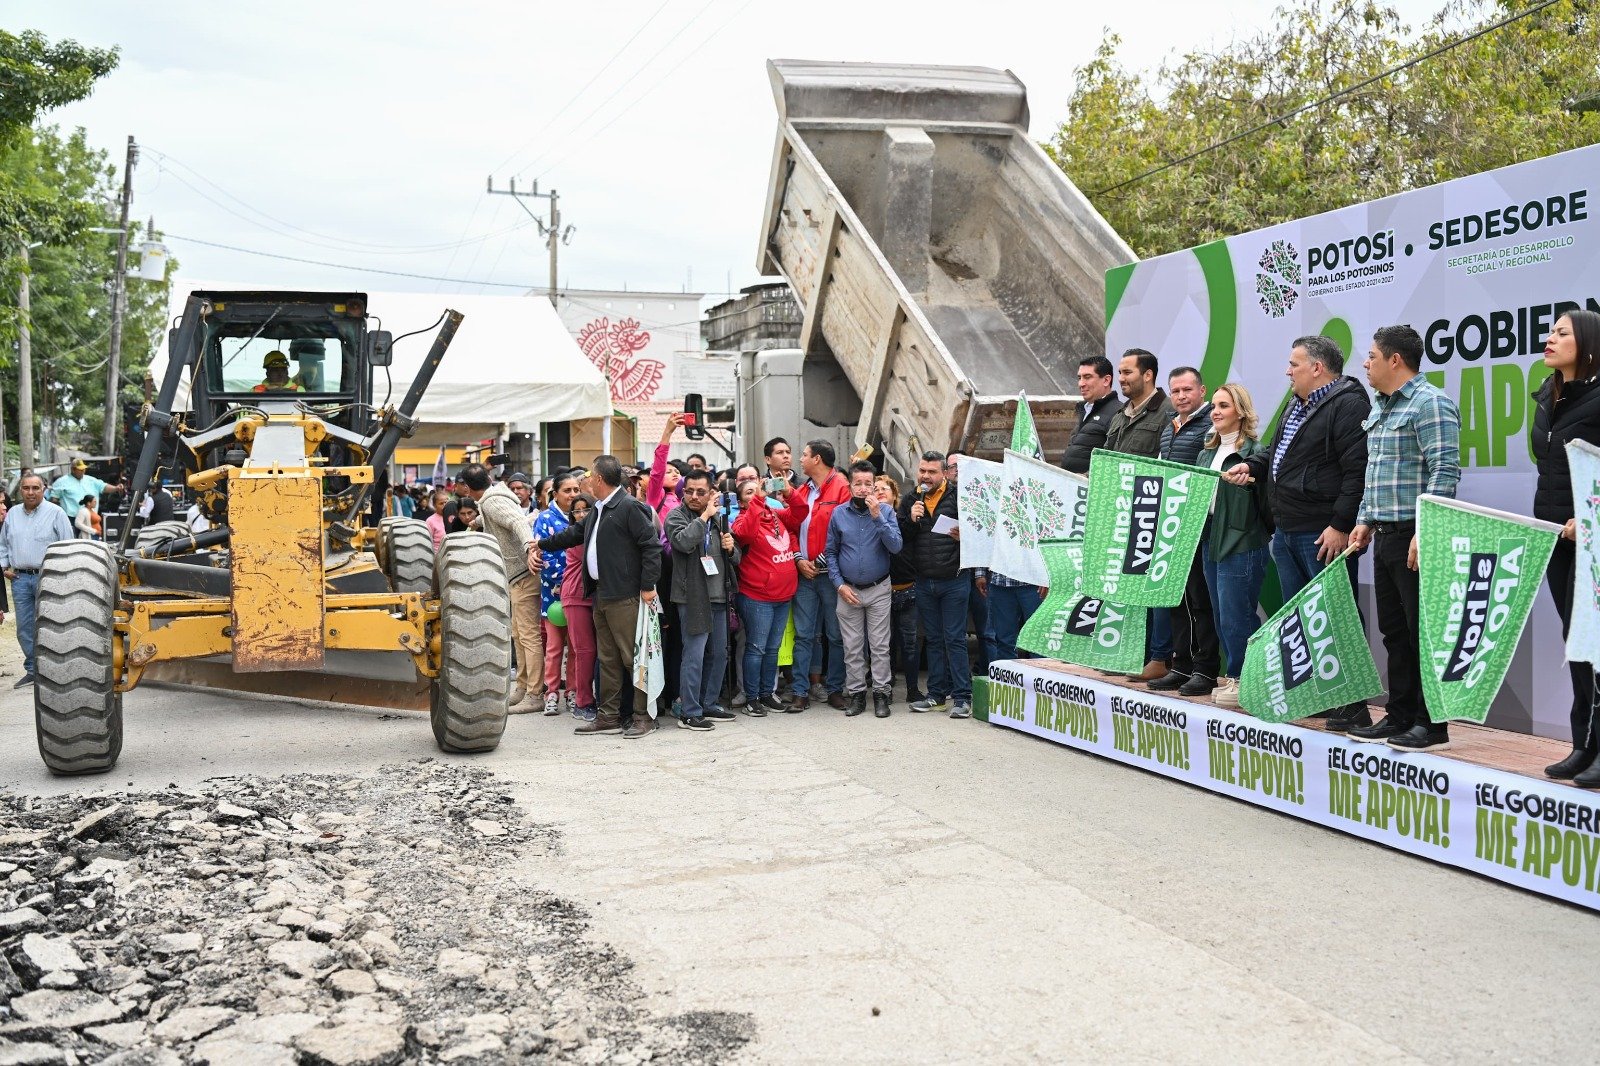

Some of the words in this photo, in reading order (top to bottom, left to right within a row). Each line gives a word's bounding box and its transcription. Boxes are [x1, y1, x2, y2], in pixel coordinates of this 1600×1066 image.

[1428, 189, 1588, 250] SEDESORE
[1447, 249, 1498, 268] SECRETARÍA
[1500, 248, 1511, 258] DE
[1513, 236, 1575, 256] DESARROLLO
[1466, 262, 1497, 275] SOCIAL
[1499, 261, 1506, 269] Y
[1506, 252, 1552, 268] REGIONAL
[1307, 286, 1334, 298] GOBIERNO
[1334, 284, 1345, 293] DEL
[1345, 281, 1366, 291] ESTADO
[1308, 275, 1330, 287] PARA
[1330, 271, 1346, 284] LOS
[1347, 262, 1395, 280] POTOSINOS
[1424, 297, 1600, 365] GOBIE
[1046, 681, 1096, 706] GOBIERNO
[1034, 692, 1054, 730] ME
[1054, 701, 1099, 744] APOYA!
[1126, 702, 1187, 730] GOBIERNO
[1112, 713, 1135, 755] ME
[1137, 720, 1190, 771] APOYA!
[1225, 722, 1303, 759] GOBIERNO
[1208, 738, 1236, 784] ME
[1239, 746, 1305, 806] APOYA!
[1351, 752, 1449, 795] GOBIERNO
[1328, 769, 1362, 823] ME
[1365, 779, 1451, 849] APOYA!
[1475, 782, 1504, 810] ¡EL
[1475, 806, 1518, 869] ME
[1522, 819, 1600, 895] APOY
